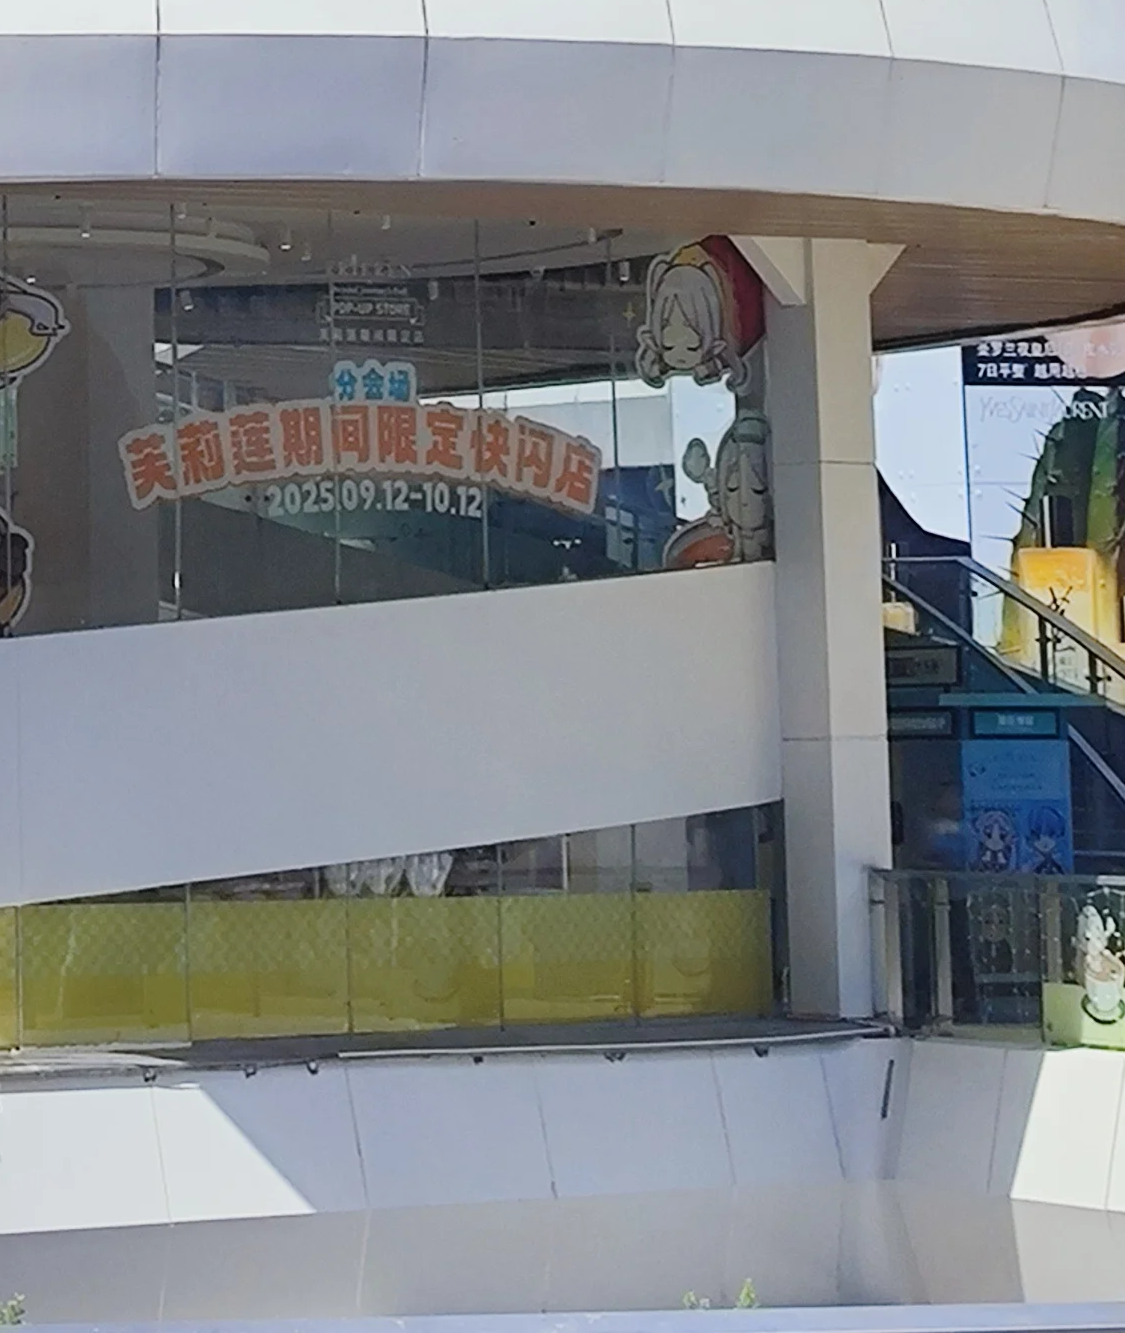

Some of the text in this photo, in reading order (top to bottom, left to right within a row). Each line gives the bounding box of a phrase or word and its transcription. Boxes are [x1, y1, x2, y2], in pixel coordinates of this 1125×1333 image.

[335, 368, 409, 402] 分会场
[125, 405, 597, 507] 芙莉莲期间限定快闪店
